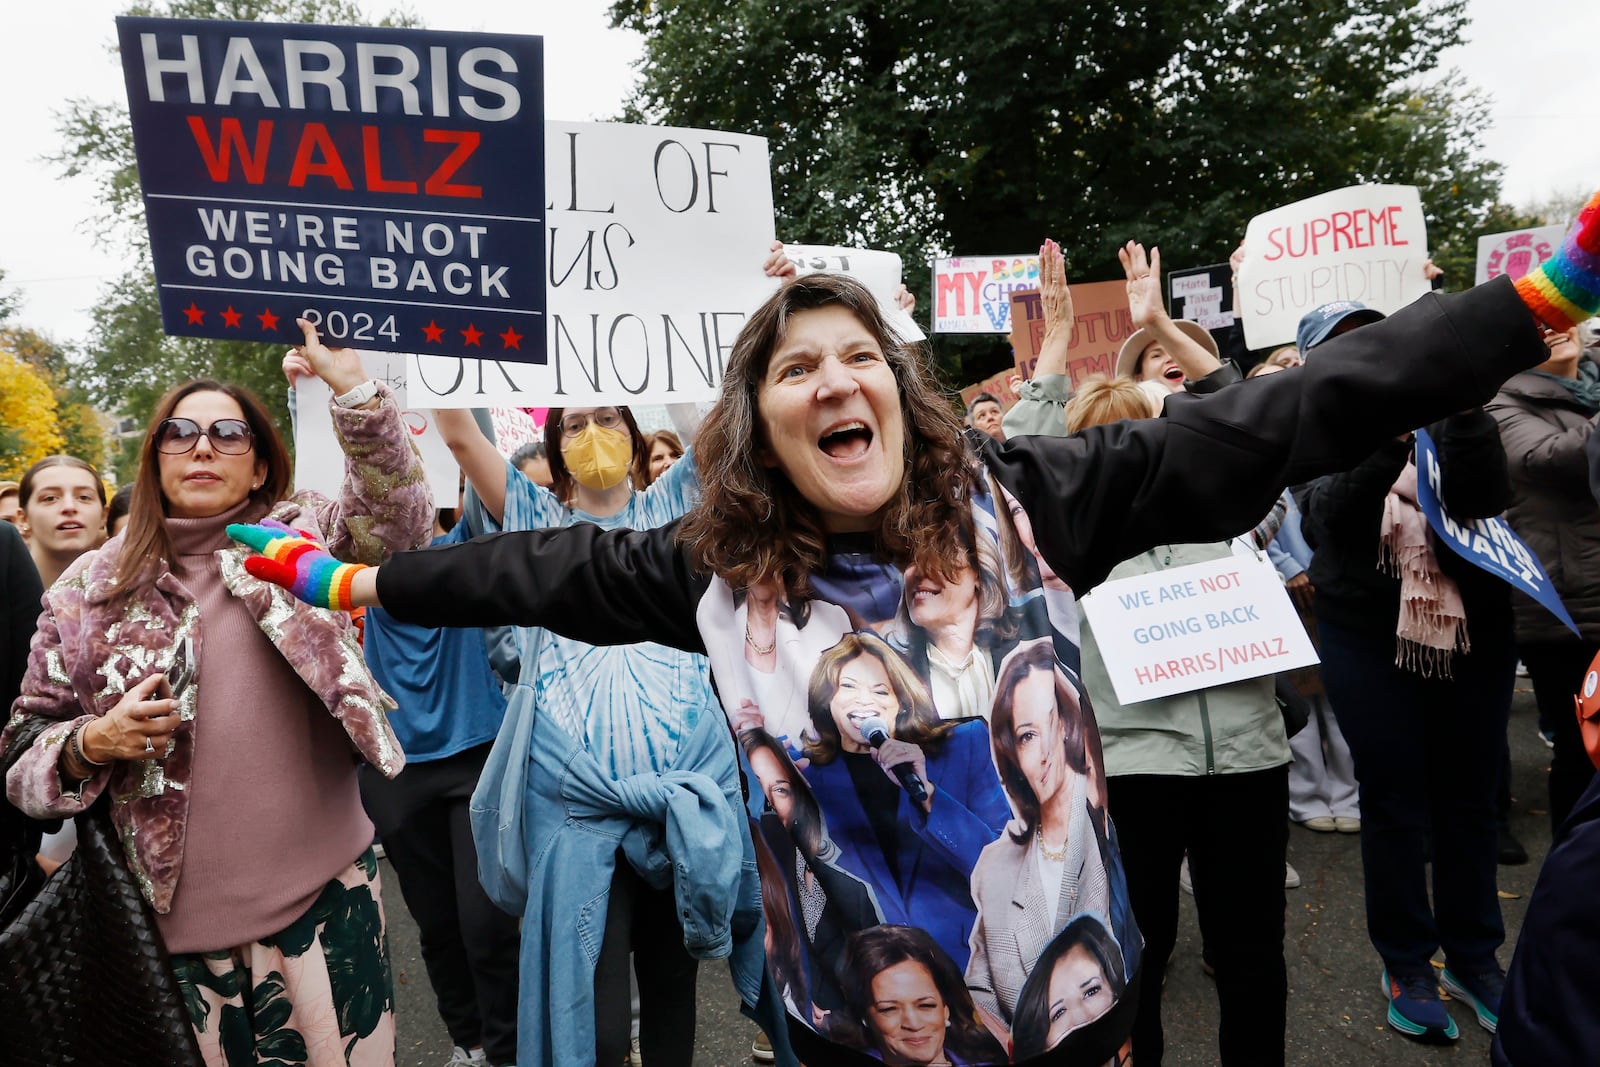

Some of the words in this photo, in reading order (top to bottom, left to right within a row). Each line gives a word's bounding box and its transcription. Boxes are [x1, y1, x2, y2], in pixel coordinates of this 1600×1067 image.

[140, 33, 521, 121] HARRIS
[186, 116, 482, 198] WALZ
[654, 139, 740, 213] OF
[198, 208, 361, 251] WE'RE
[385, 221, 488, 259] NOT
[549, 222, 635, 290] US
[1264, 206, 1408, 261] SUPREME
[186, 245, 345, 286] GOING
[370, 257, 511, 298] BACK
[937, 271, 987, 317] MY
[991, 258, 1040, 280] BOD
[1255, 259, 1409, 316] STUPIDITY
[302, 308, 400, 342] 2024
[1440, 506, 1540, 592] WALZ
[1118, 590, 1154, 610] WE
[1159, 581, 1197, 603] ARE
[1199, 572, 1241, 594] NOT
[1133, 617, 1201, 645] GOING
[1205, 605, 1260, 630] BACK
[1134, 637, 1290, 686] HARRIS/WALZ
